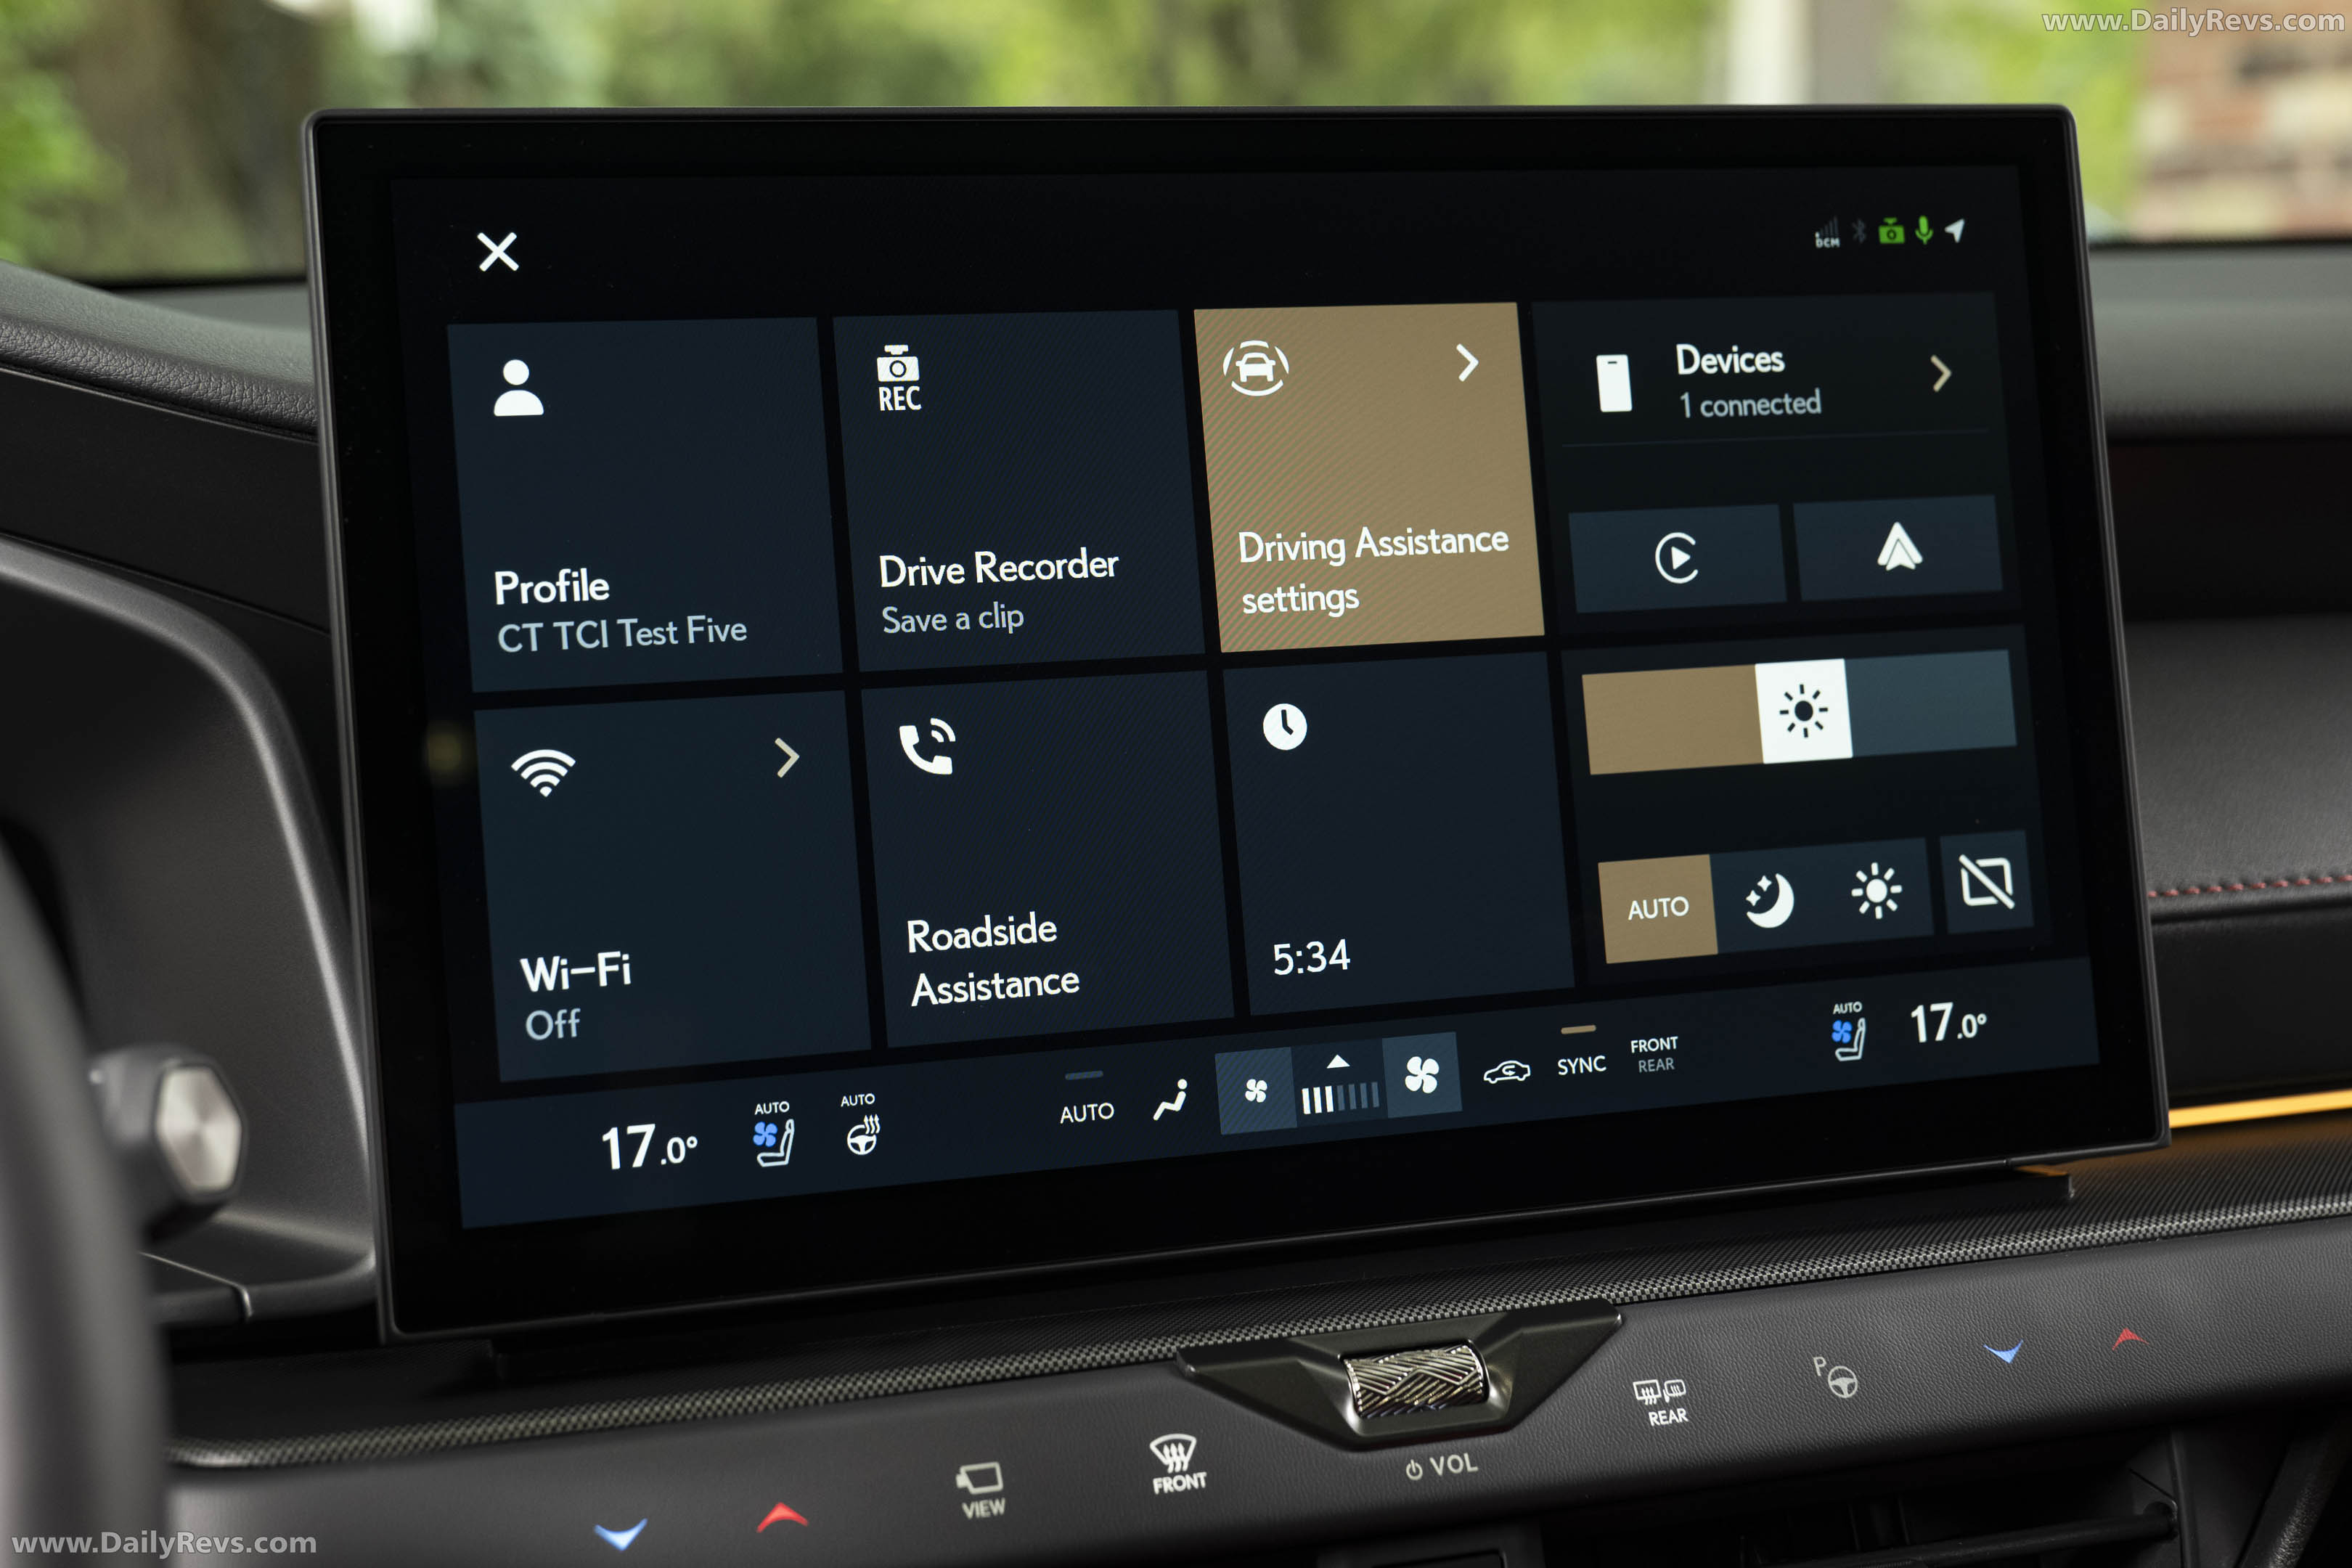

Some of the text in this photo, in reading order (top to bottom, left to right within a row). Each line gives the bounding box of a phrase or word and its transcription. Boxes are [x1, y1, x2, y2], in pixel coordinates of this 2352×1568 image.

[1815, 237, 1841, 248] DCM
[1676, 343, 1786, 375] Devices
[878, 385, 922, 412] REC
[1681, 387, 1822, 418] 1 connected
[1238, 526, 1509, 567] Driving Assistance
[879, 547, 1119, 588] Drive Recorder
[494, 567, 610, 605] Profile
[1242, 583, 1360, 618] settings
[882, 601, 1024, 634] Save a clip
[498, 615, 748, 653] CT TCI Test Five
[1628, 896, 1689, 920] AUTO
[907, 911, 1058, 953] Roadside
[1273, 939, 1351, 976] 5:34
[911, 972, 1080, 1007] Assistance
[1832, 1001, 1863, 1015] AUTO
[526, 1008, 581, 1040] Off
[1630, 1036, 1678, 1053] FRONT
[1557, 1055, 1606, 1076] SYNC
[1638, 1057, 1675, 1073] REAR
[754, 1101, 790, 1115] AUTO
[841, 1093, 875, 1107] AUTO
[1060, 1102, 1114, 1124] AUTO
[1813, 1356, 1827, 1377] P
[1648, 1408, 1689, 1426] REAR
[1429, 1453, 1479, 1476] VOL
[1153, 1471, 1207, 1494] FRONT
[962, 1498, 1005, 1519] VIEW
